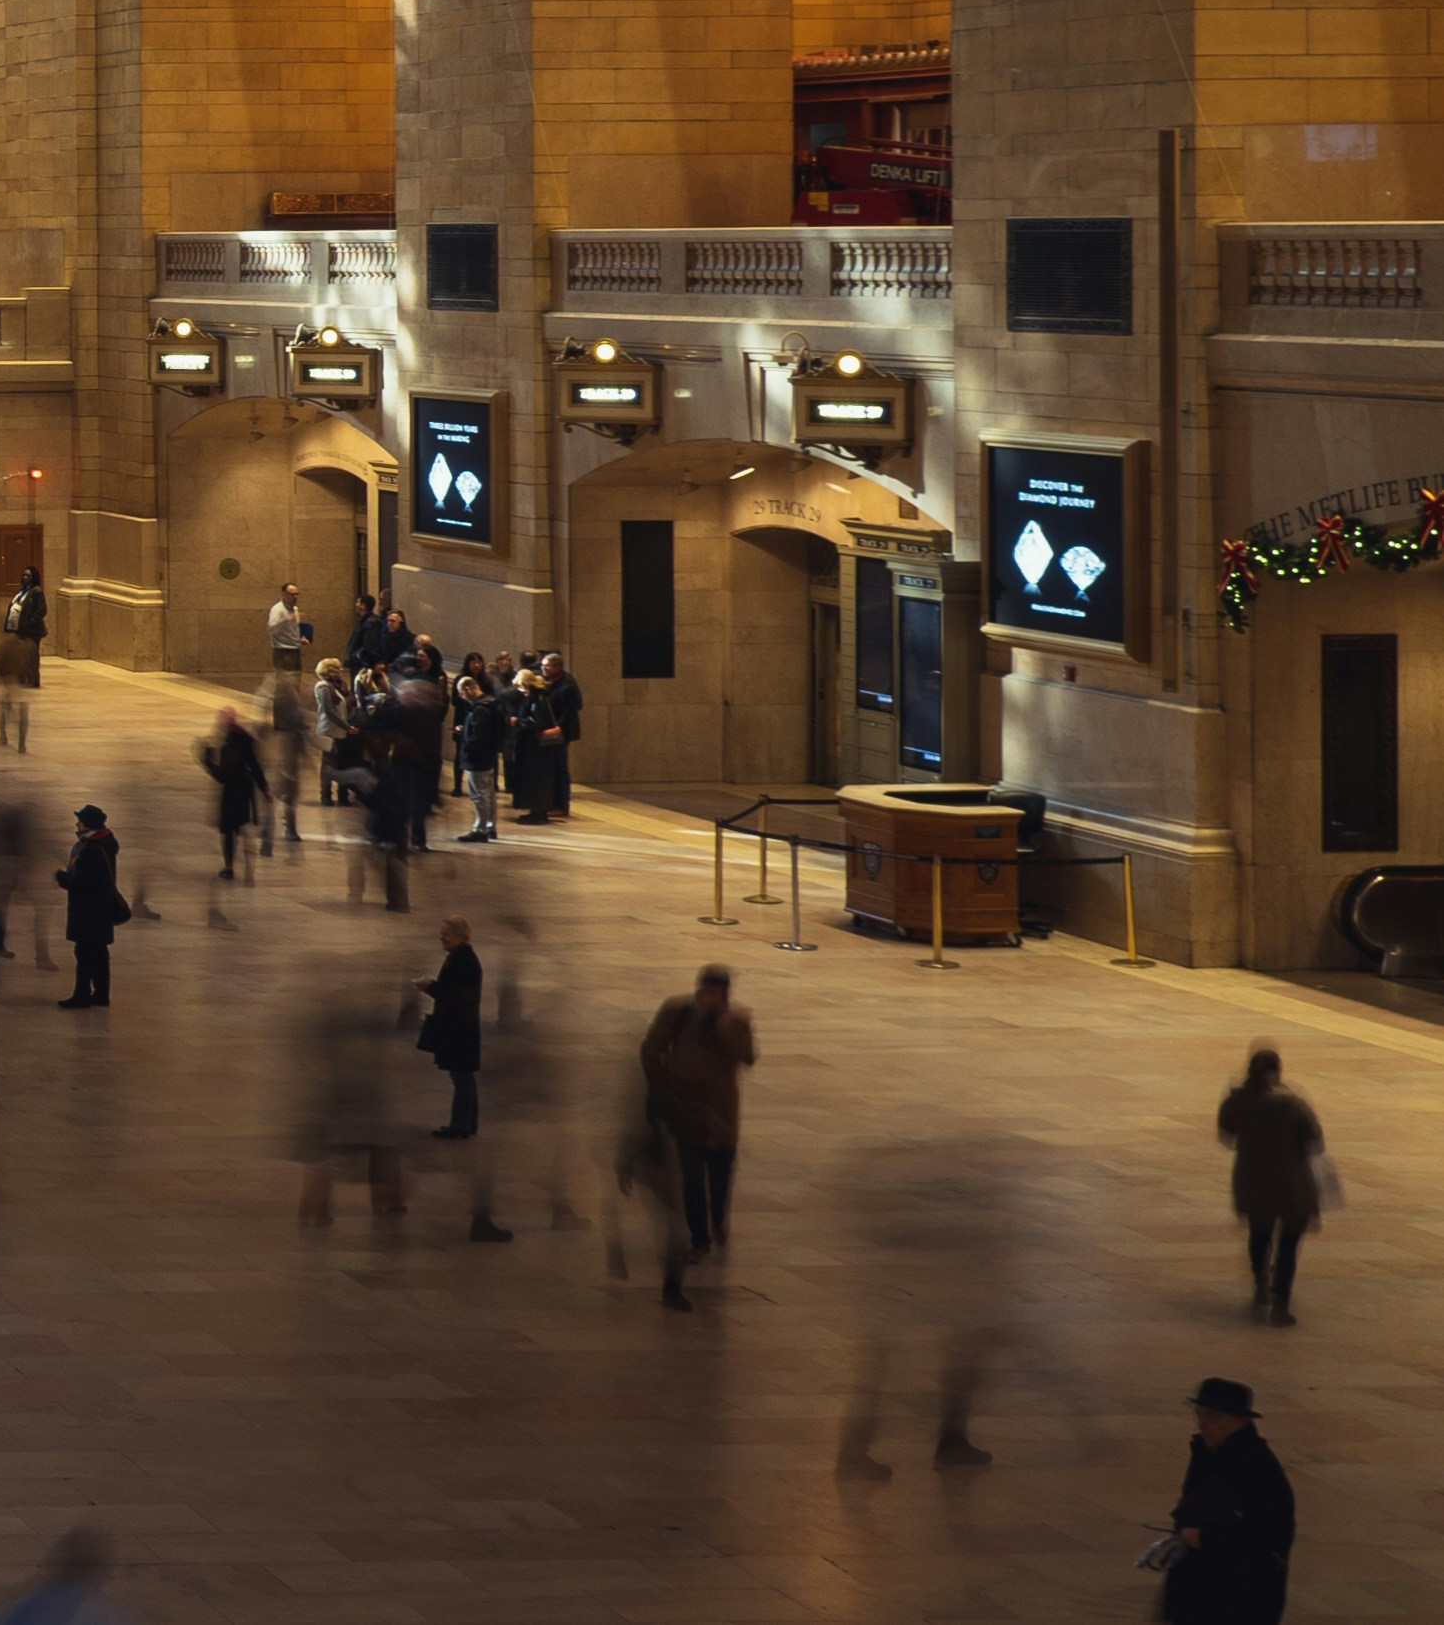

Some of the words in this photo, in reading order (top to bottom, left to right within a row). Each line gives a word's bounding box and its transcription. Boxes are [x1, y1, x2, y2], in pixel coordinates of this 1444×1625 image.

[870, 163, 912, 181] DENKA
[915, 169, 939, 184] LIFT
[768, 500, 806, 518] TRACK
[809, 507, 821, 522] 29
[1018, 492, 1057, 505] DIAMOND
[1059, 497, 1096, 509] JOURNEY
[1296, 479, 1401, 531] METLIFE
